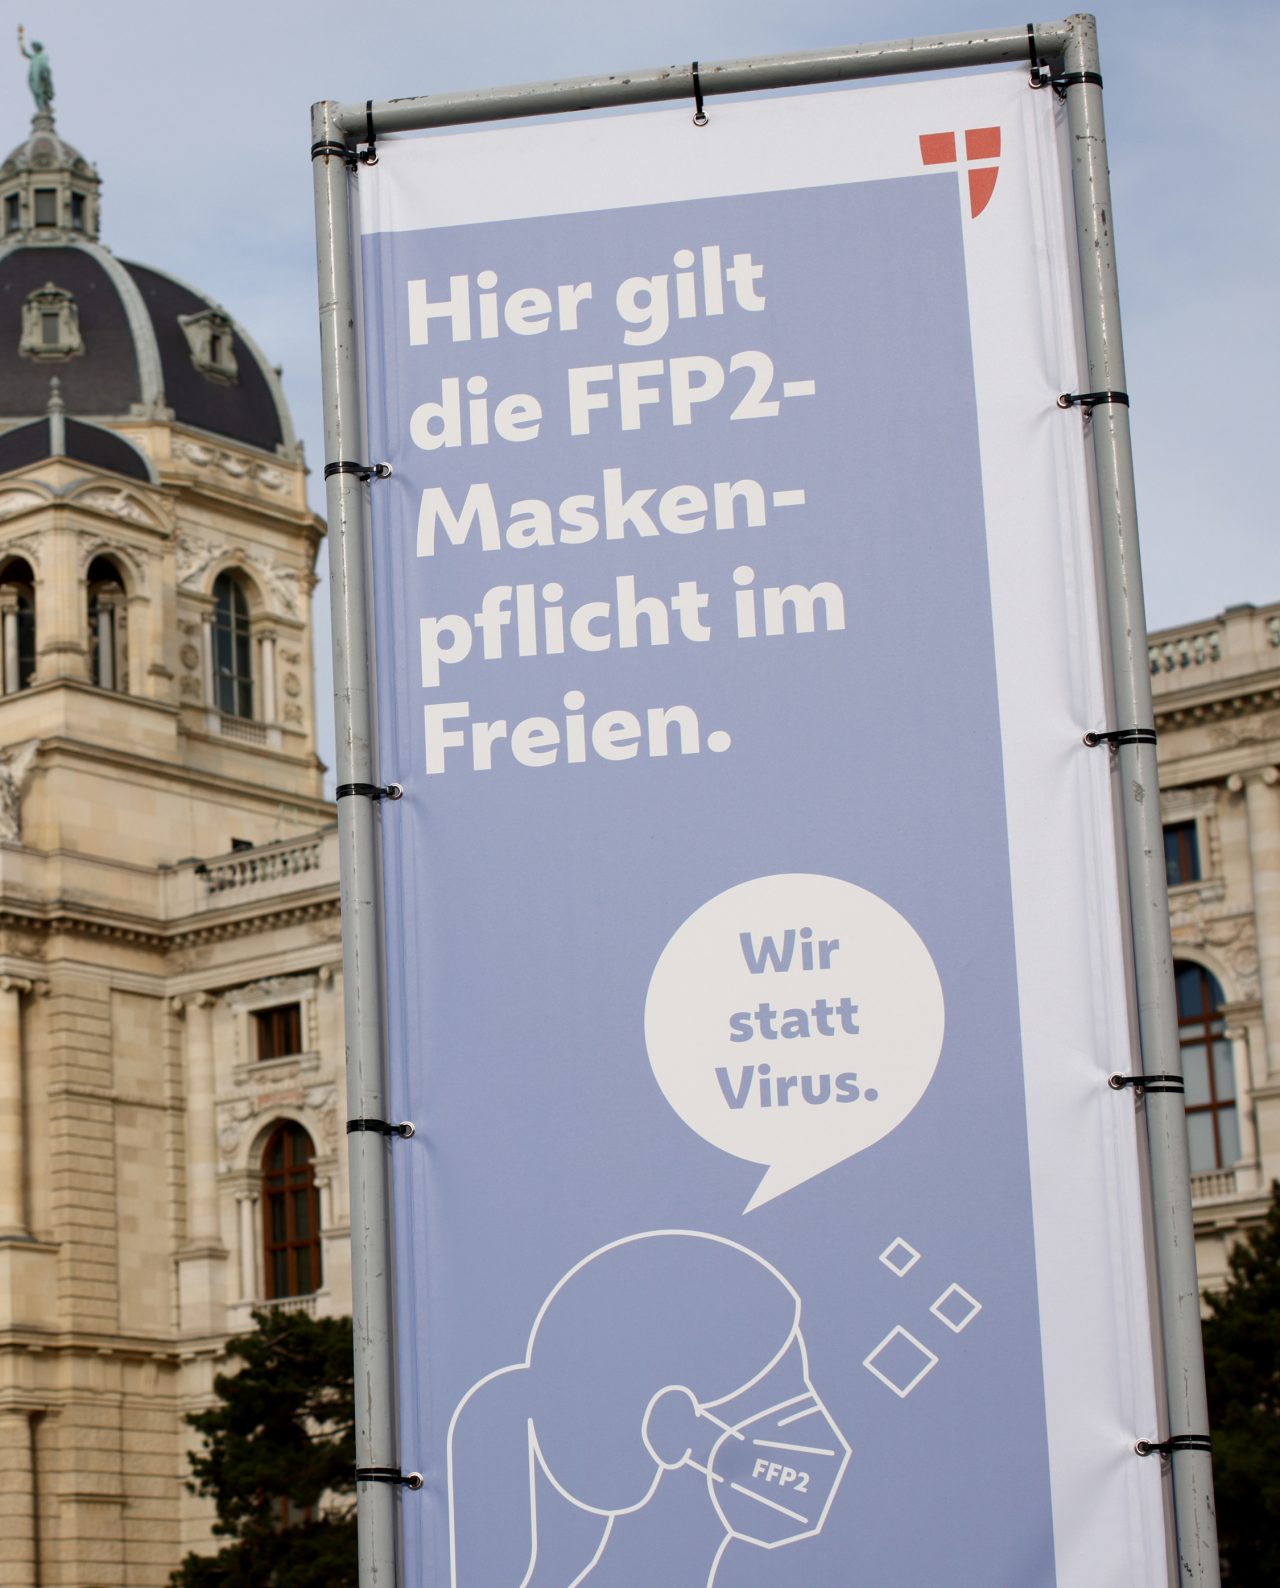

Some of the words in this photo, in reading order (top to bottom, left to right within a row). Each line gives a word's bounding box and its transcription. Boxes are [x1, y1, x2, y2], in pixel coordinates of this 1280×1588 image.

[408, 271, 592, 345] Hier
[616, 245, 765, 346] gilt
[410, 376, 542, 450] die
[568, 351, 815, 435] FFP2-
[417, 468, 805, 557] Masken-
[420, 575, 710, 687] pflicht
[733, 566, 845, 638] im
[422, 691, 731, 774] Freien.
[740, 927, 839, 974] Wir
[729, 998, 859, 1042] statt
[715, 1064, 878, 1109] Virus.
[752, 1458, 810, 1493] FFP2
